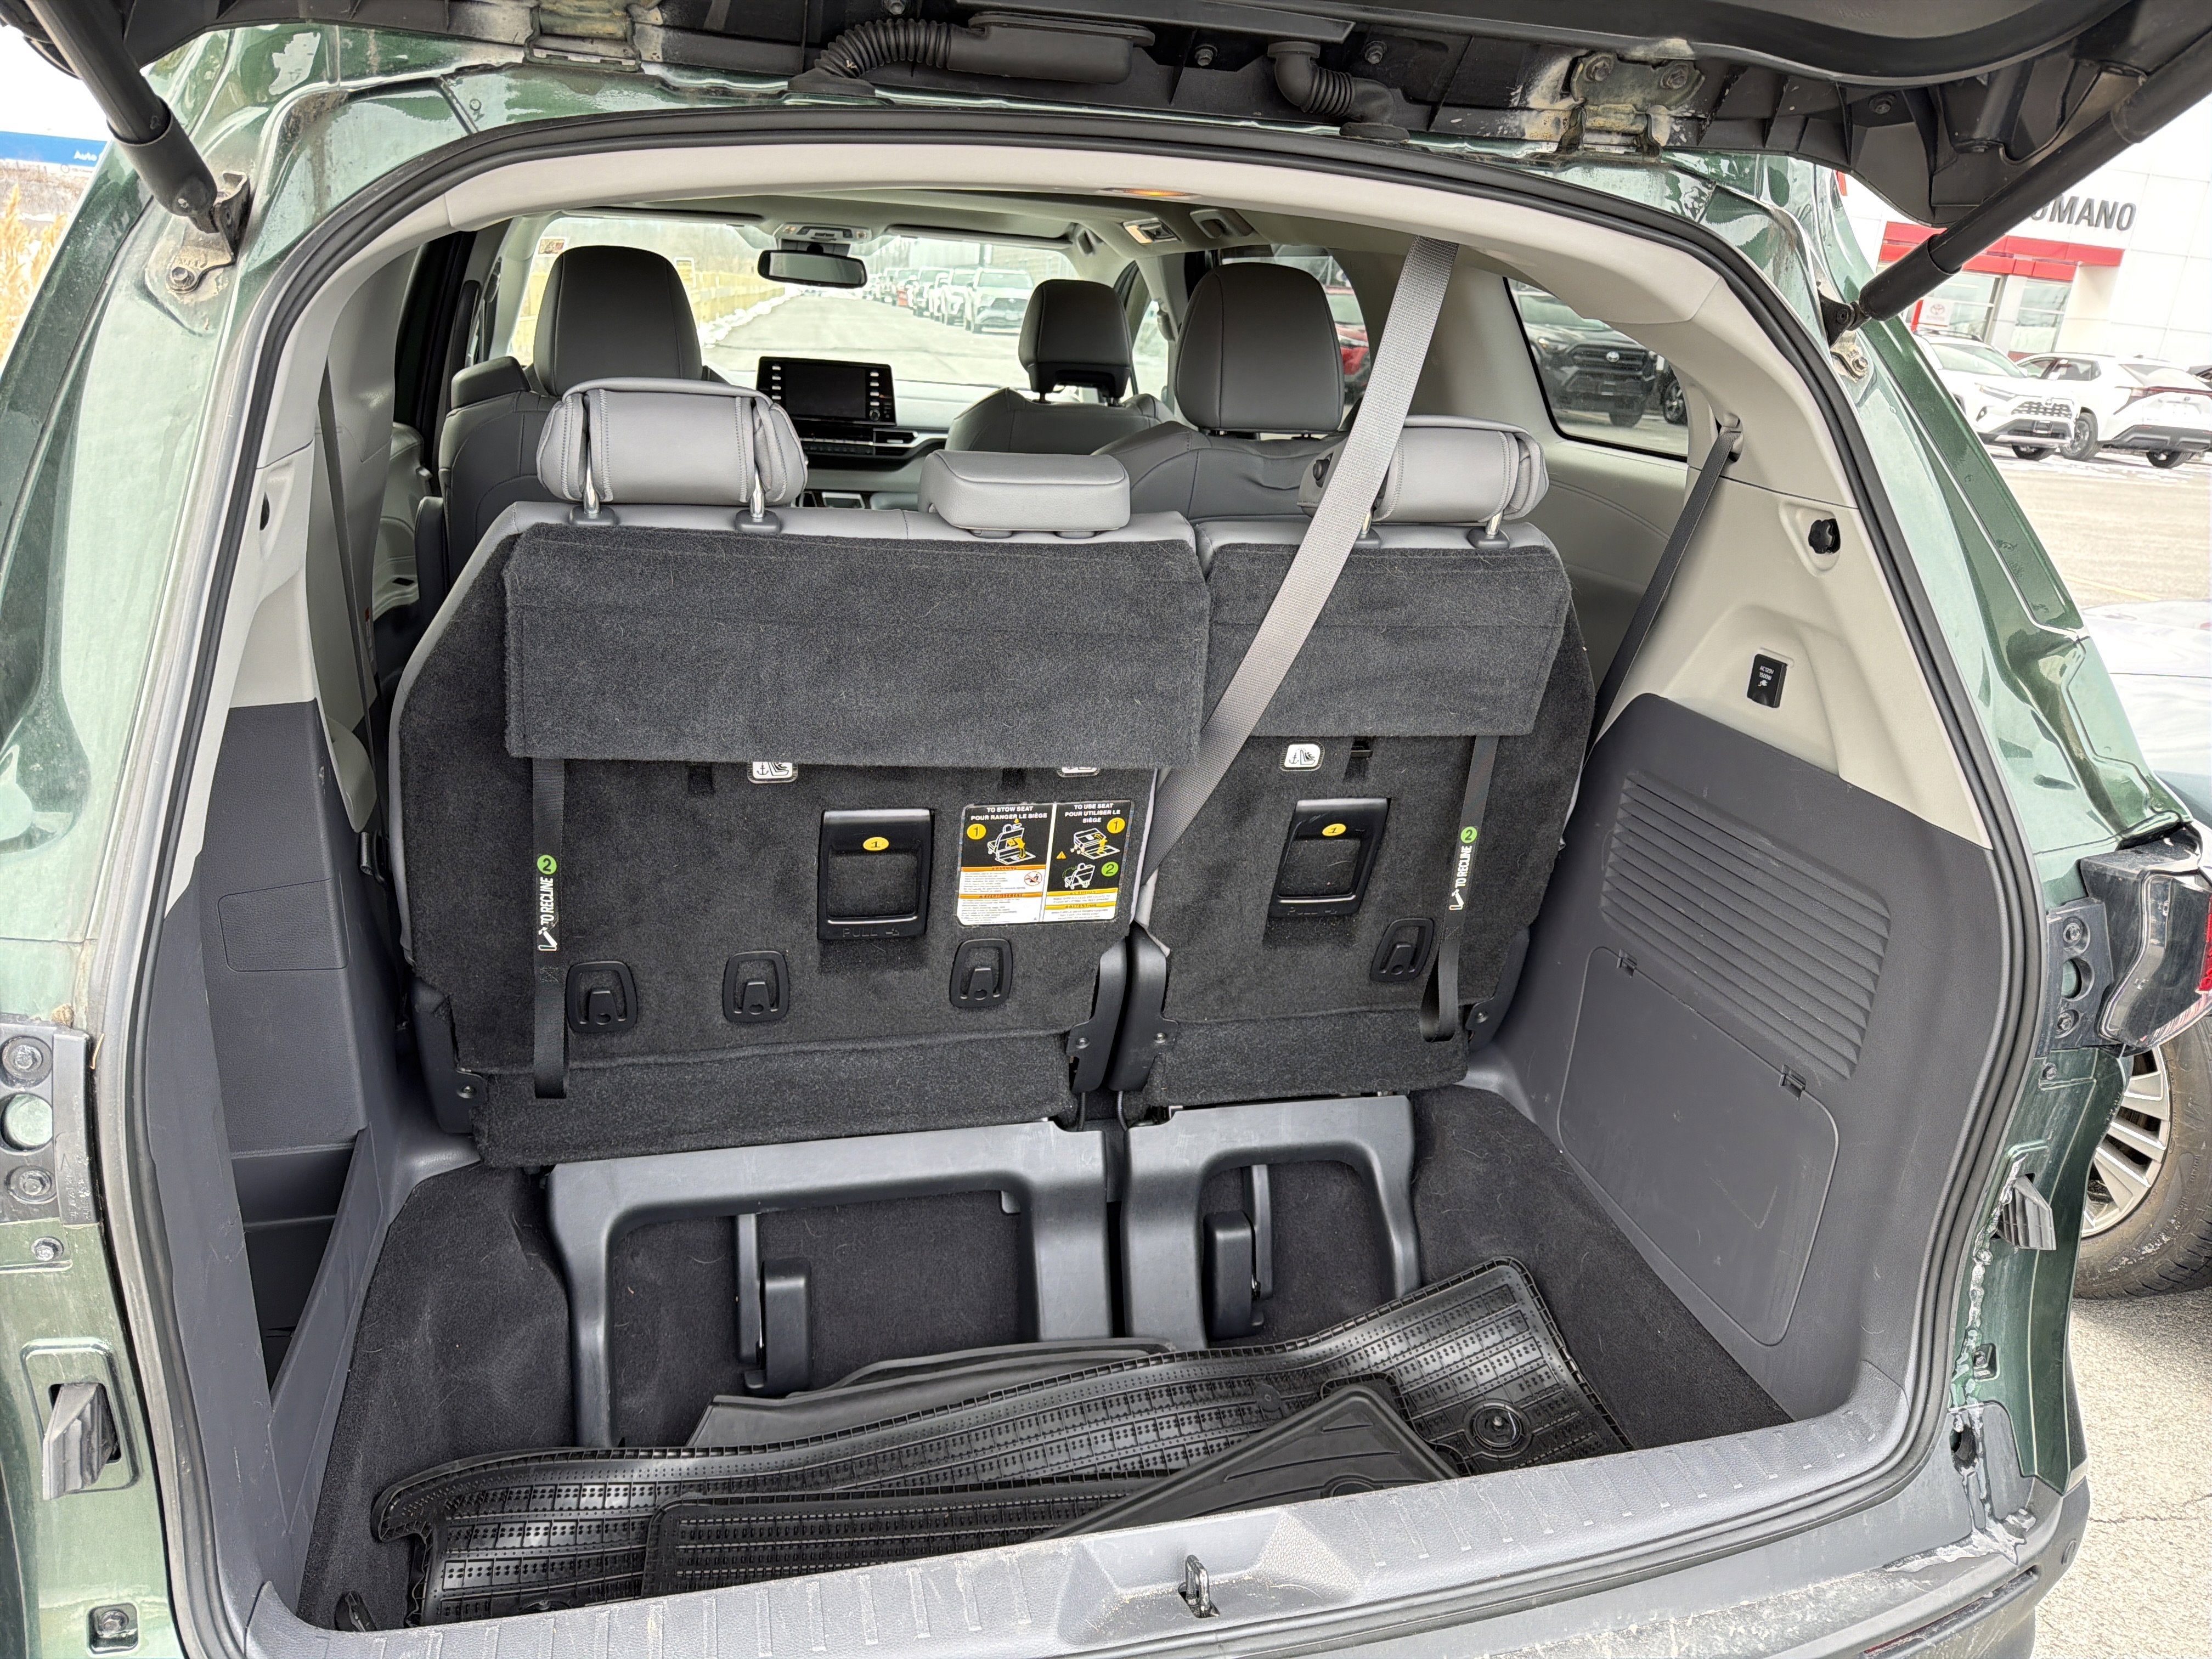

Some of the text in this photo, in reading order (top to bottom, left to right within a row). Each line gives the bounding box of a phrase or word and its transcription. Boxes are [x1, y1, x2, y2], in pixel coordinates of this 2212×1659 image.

[74, 149, 97, 161] Auto
[1464, 829, 1473, 841] 2
[542, 857, 551, 872] 2
[1105, 864, 1115, 874] 2
[1454, 845, 1472, 888] TO RECLINE
[540, 876, 555, 926] TO RECLINE
[842, 928, 878, 938] PULL
